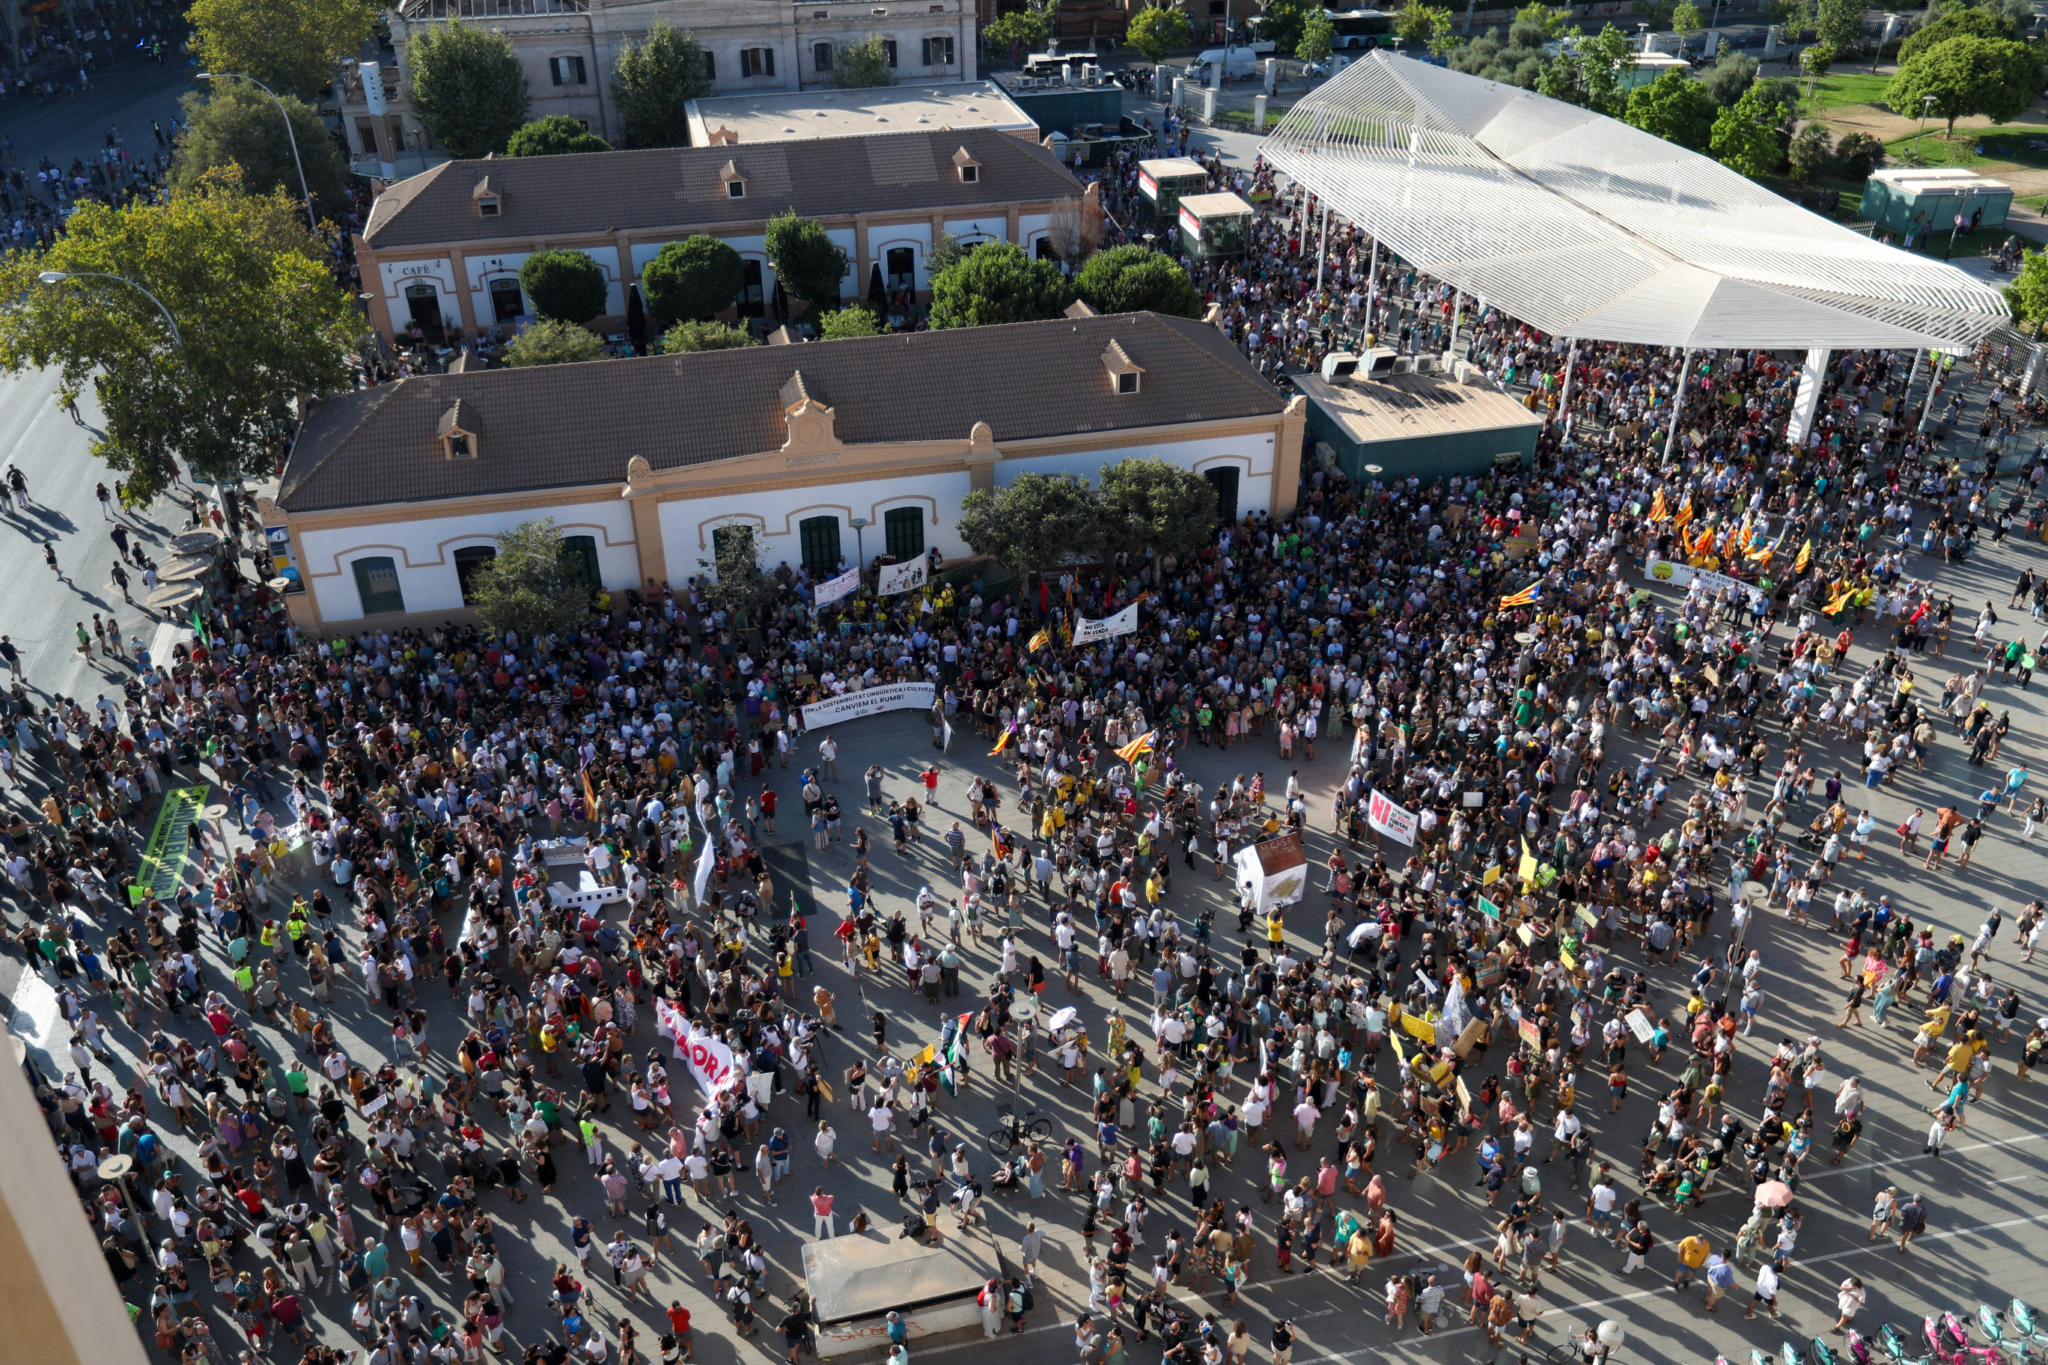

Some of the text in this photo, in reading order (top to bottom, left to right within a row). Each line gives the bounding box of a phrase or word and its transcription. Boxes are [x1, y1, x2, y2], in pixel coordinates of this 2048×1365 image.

[403, 264, 430, 275] CAFÉ
[823, 694, 866, 709] SOSTENIBILITAT
[866, 687, 903, 697] LINGÜÍSTICA
[835, 700, 869, 713] CANVIEM
[879, 694, 904, 703] RUMB!
[1371, 794, 1391, 825] NI
[162, 841, 185, 859] EL
[1260, 837, 1293, 851] SA CASA
